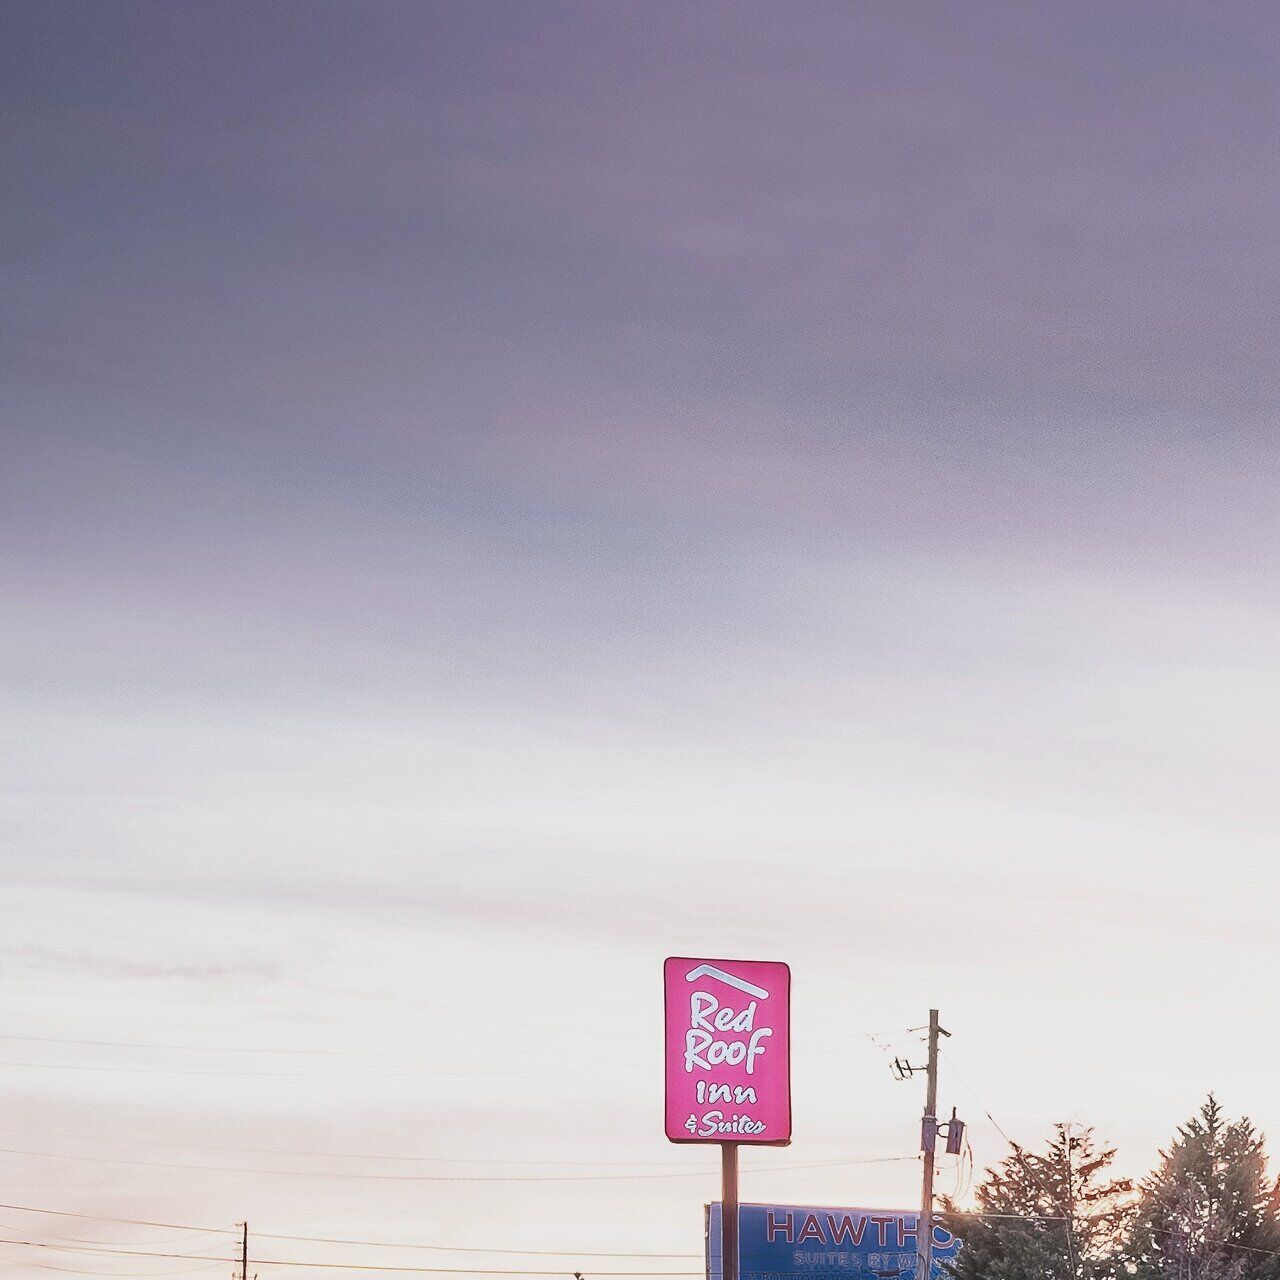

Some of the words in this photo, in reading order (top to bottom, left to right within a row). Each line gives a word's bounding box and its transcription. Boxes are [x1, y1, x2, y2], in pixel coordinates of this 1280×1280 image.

[690, 991, 757, 1033] Red
[684, 1027, 773, 1075] Roof
[696, 1080, 758, 1105] Inn
[684, 1113, 698, 1134] &
[698, 1110, 767, 1137] Suites
[793, 1250, 862, 1268] SUITES
[867, 1252, 891, 1268] BY
